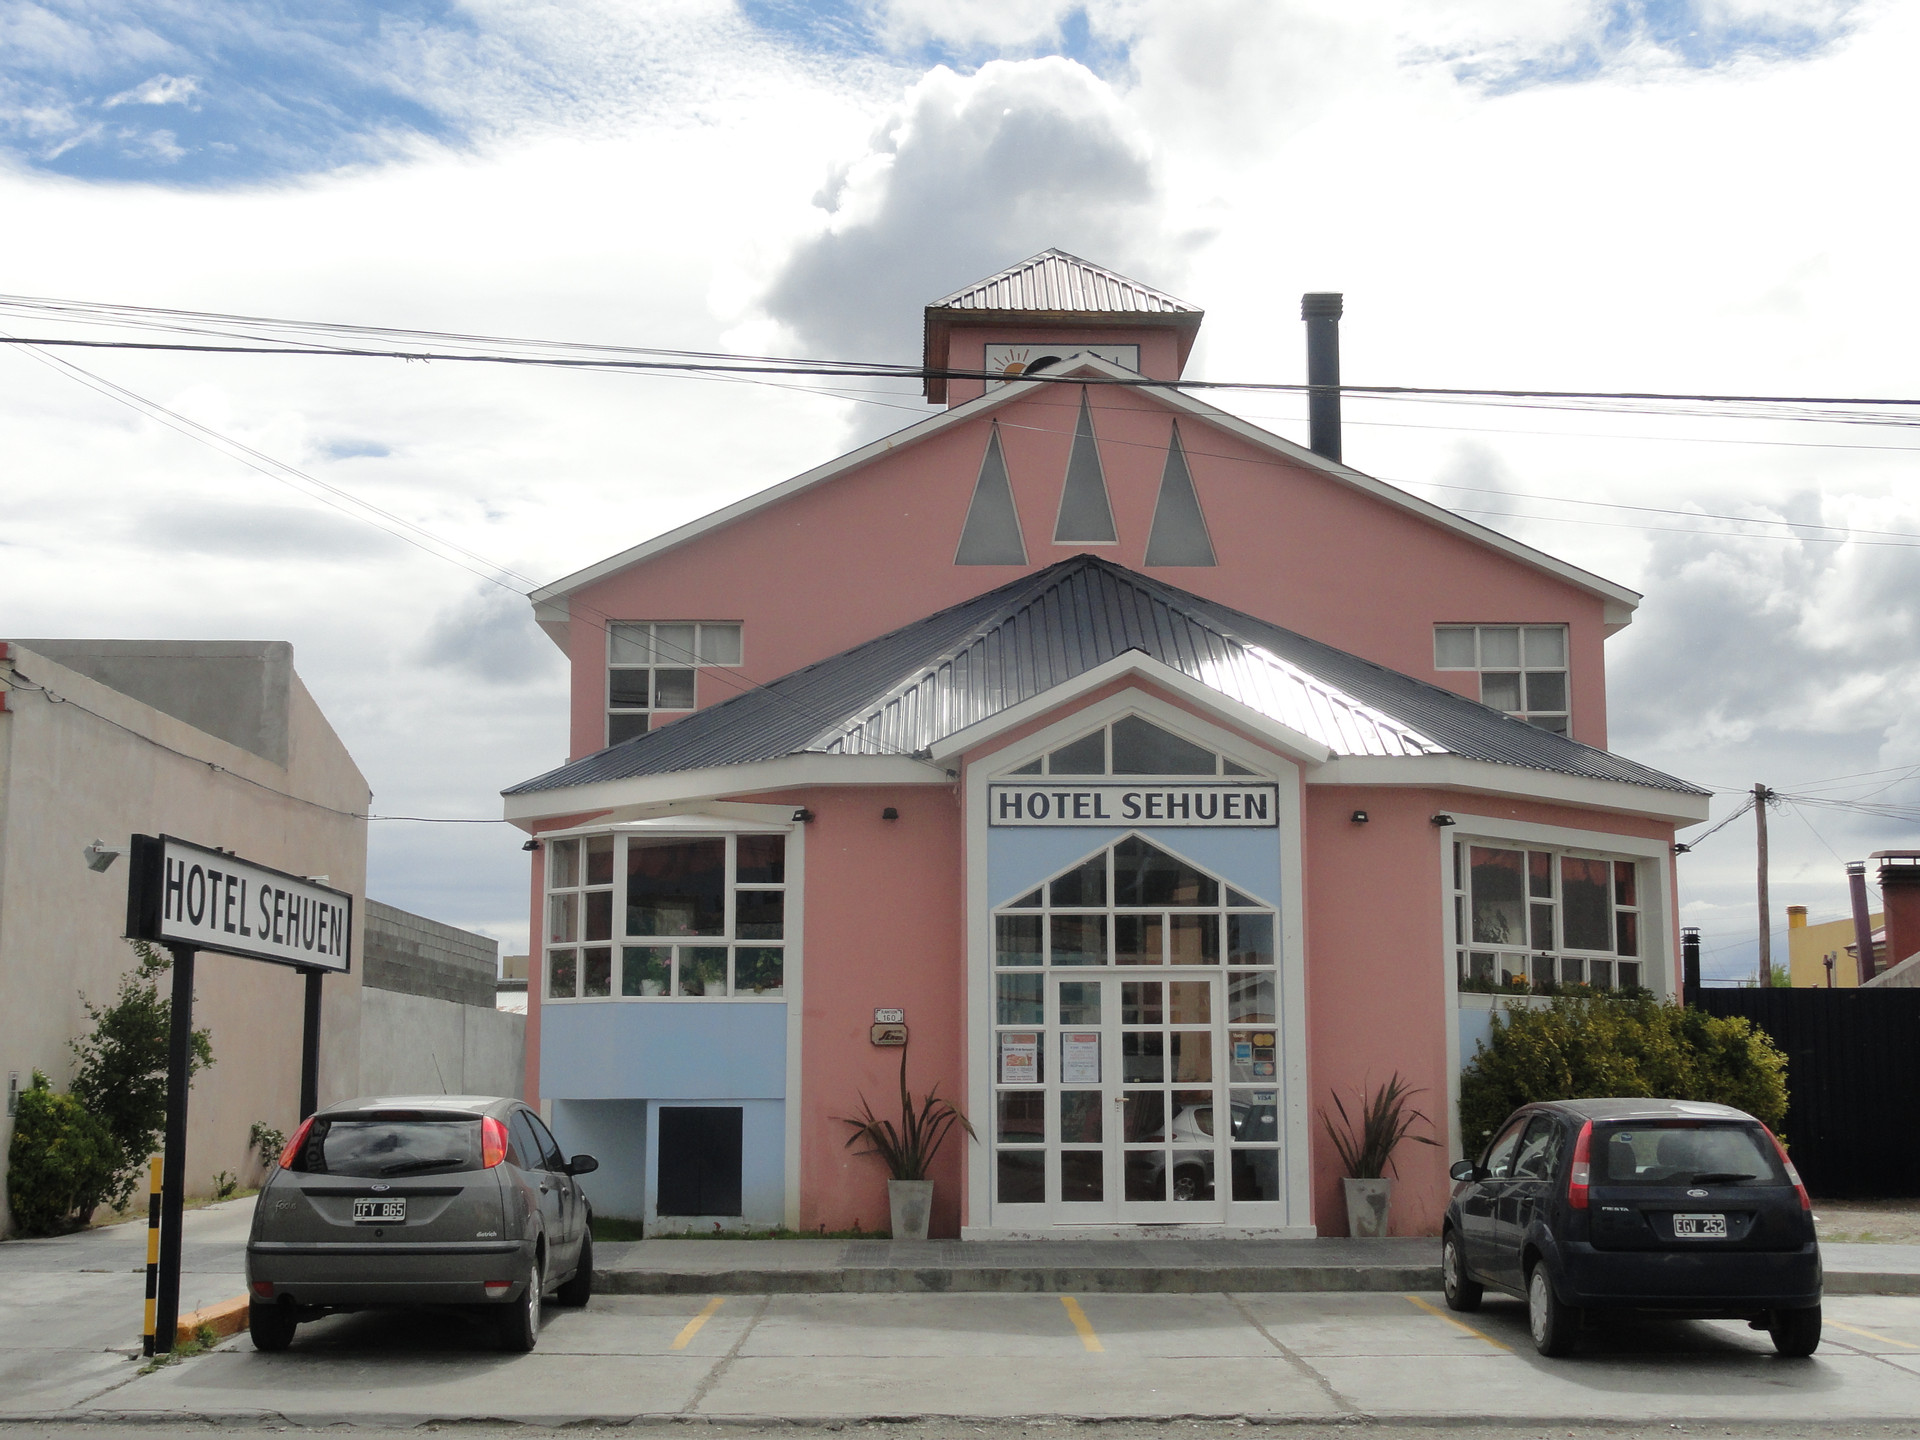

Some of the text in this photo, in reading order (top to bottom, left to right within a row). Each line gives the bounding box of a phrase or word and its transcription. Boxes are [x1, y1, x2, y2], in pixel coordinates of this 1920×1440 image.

[1000, 791, 1269, 821] HOTEL SEHUEN
[164, 856, 343, 957] HOTEL SEHUEN
[355, 1203, 404, 1217] IFY 865
[1675, 1219, 1725, 1233] EGV 252
